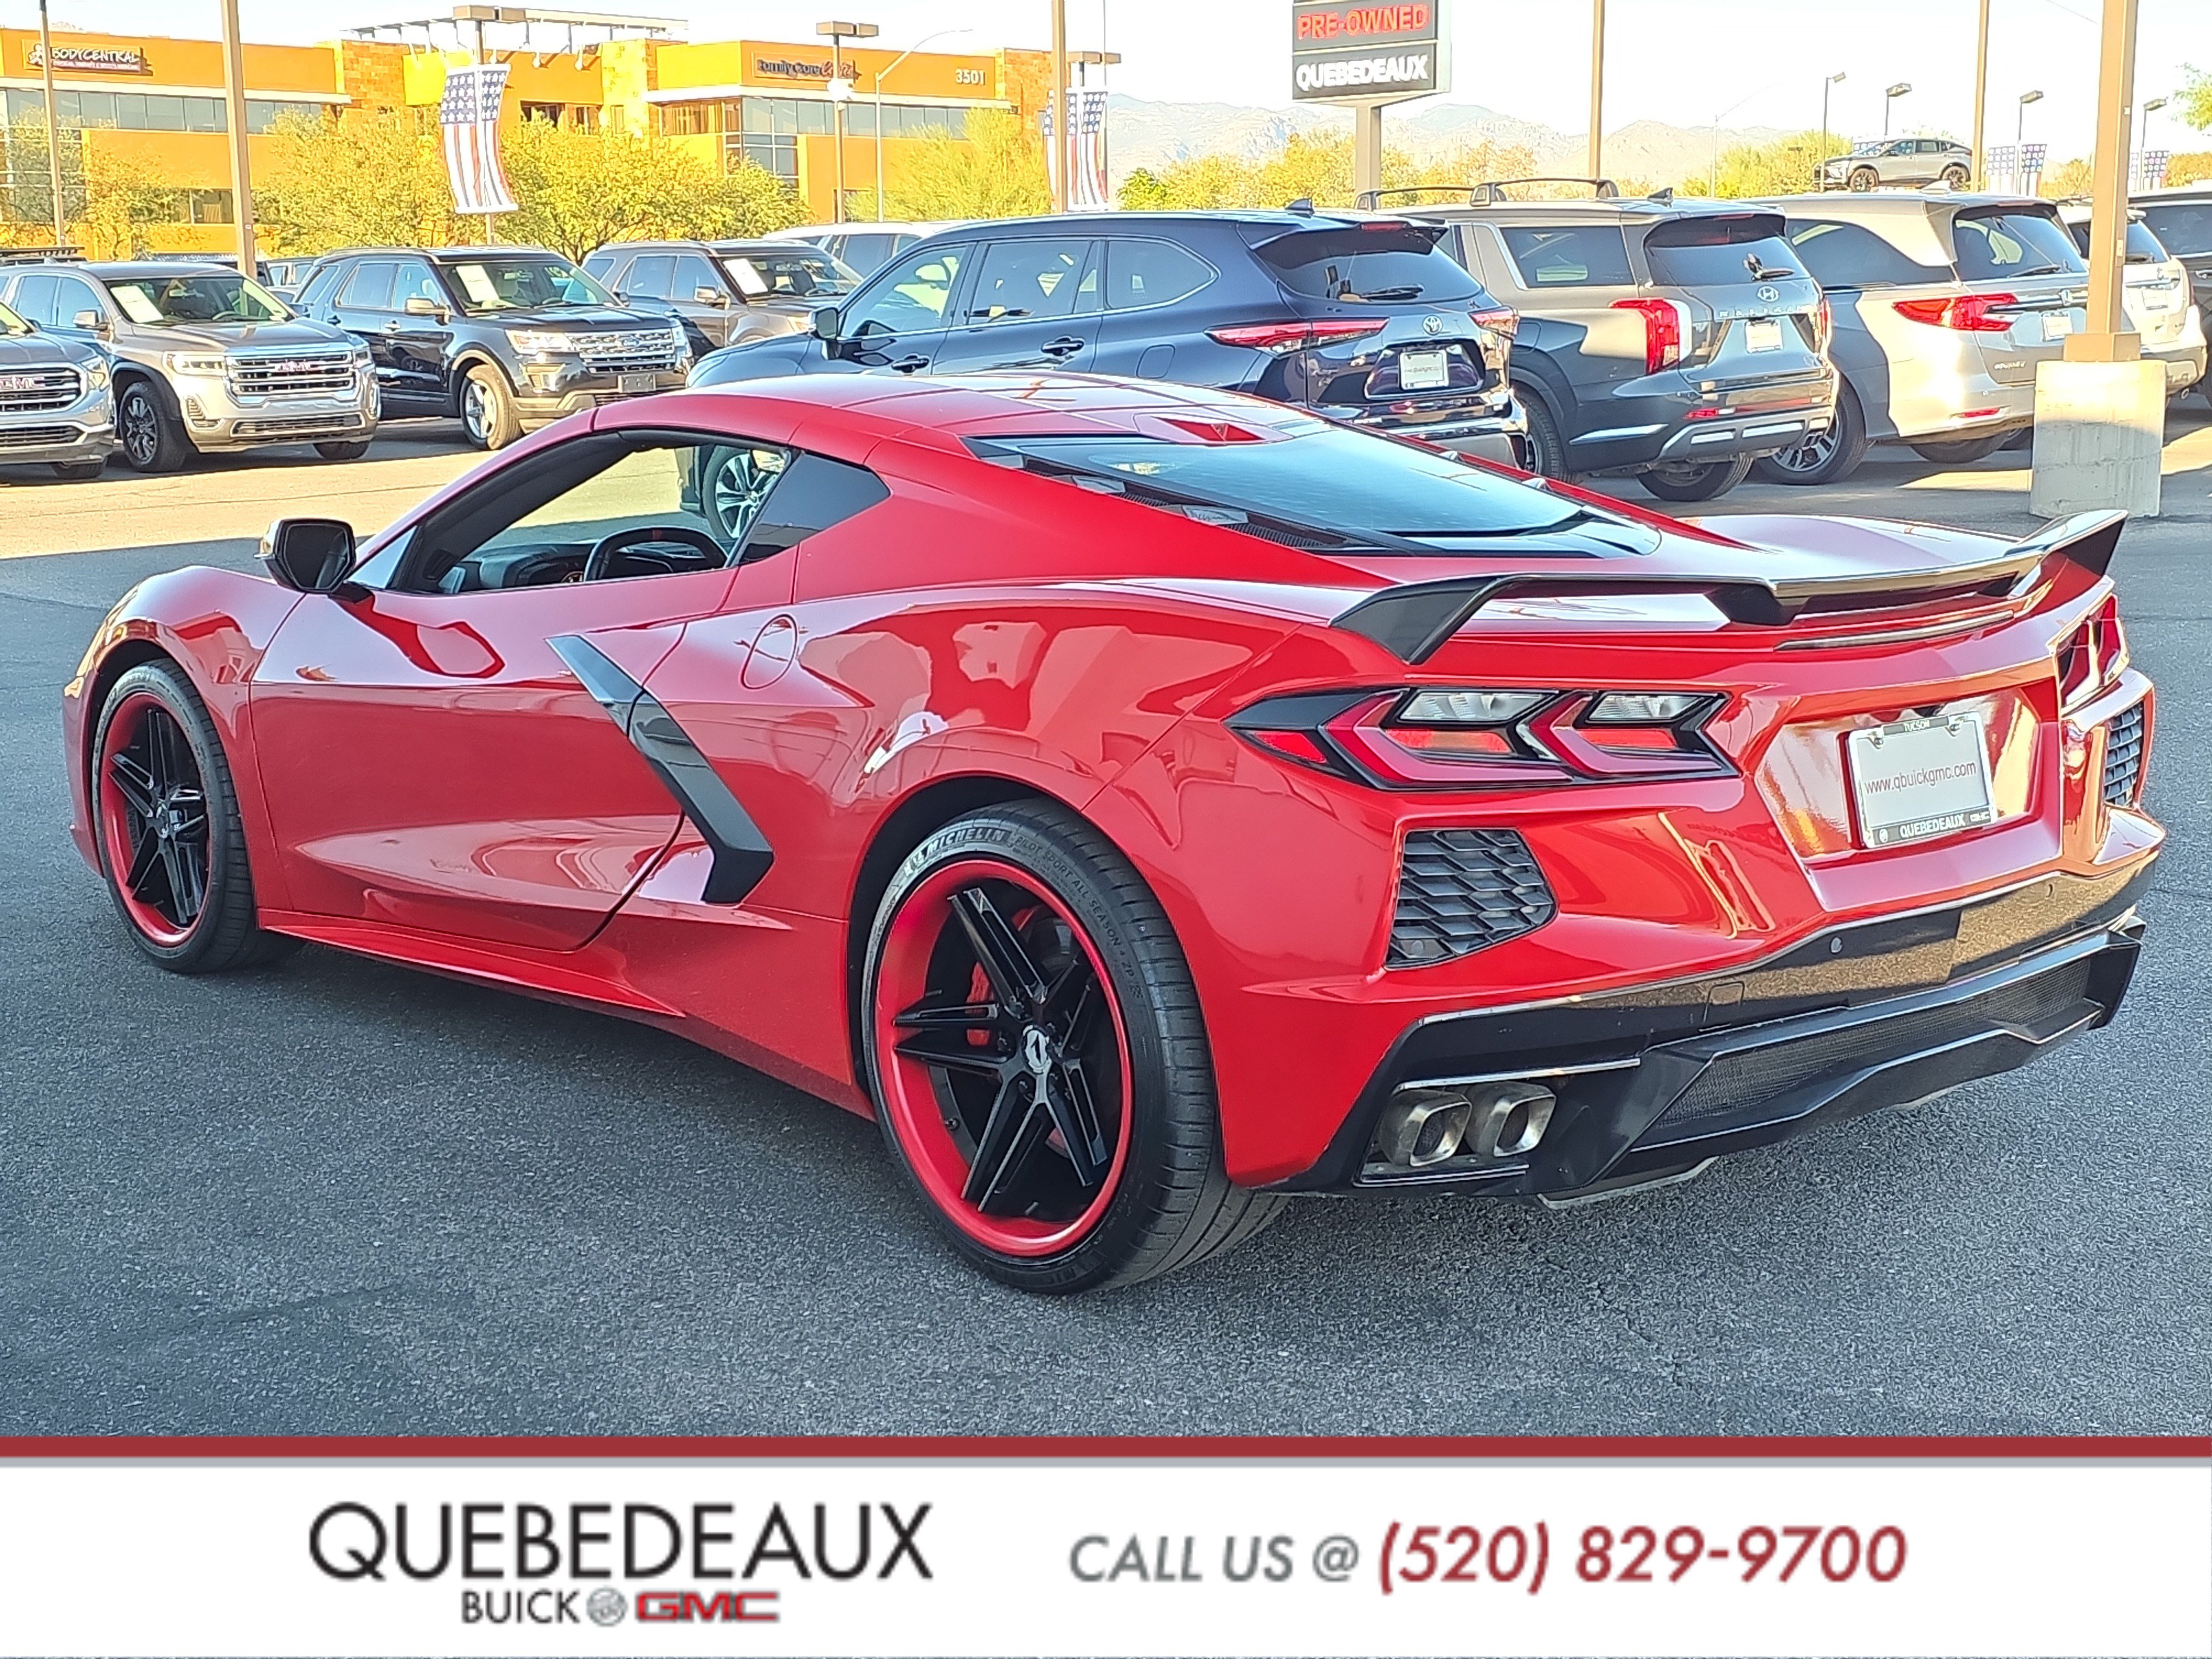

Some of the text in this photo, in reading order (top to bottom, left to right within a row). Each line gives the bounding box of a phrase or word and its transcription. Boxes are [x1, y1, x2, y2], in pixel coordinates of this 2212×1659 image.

[1297, 4, 1430, 40] PRE-OWNED
[955, 68, 986, 86] 3501
[1296, 54, 1429, 91] QUEBEDEAUX
[1903, 719, 1930, 732] TUCSON
[1864, 762, 1977, 794] www.qbuickgmc.com
[1900, 814, 1966, 838] QUEBEDEAUX
[927, 828, 1005, 855] MICHELIN
[1014, 836, 1042, 854] PILOT
[1044, 850, 1073, 878] SPORT
[1071, 879, 1089, 899] ALL
[1089, 900, 1121, 947] SEASON
